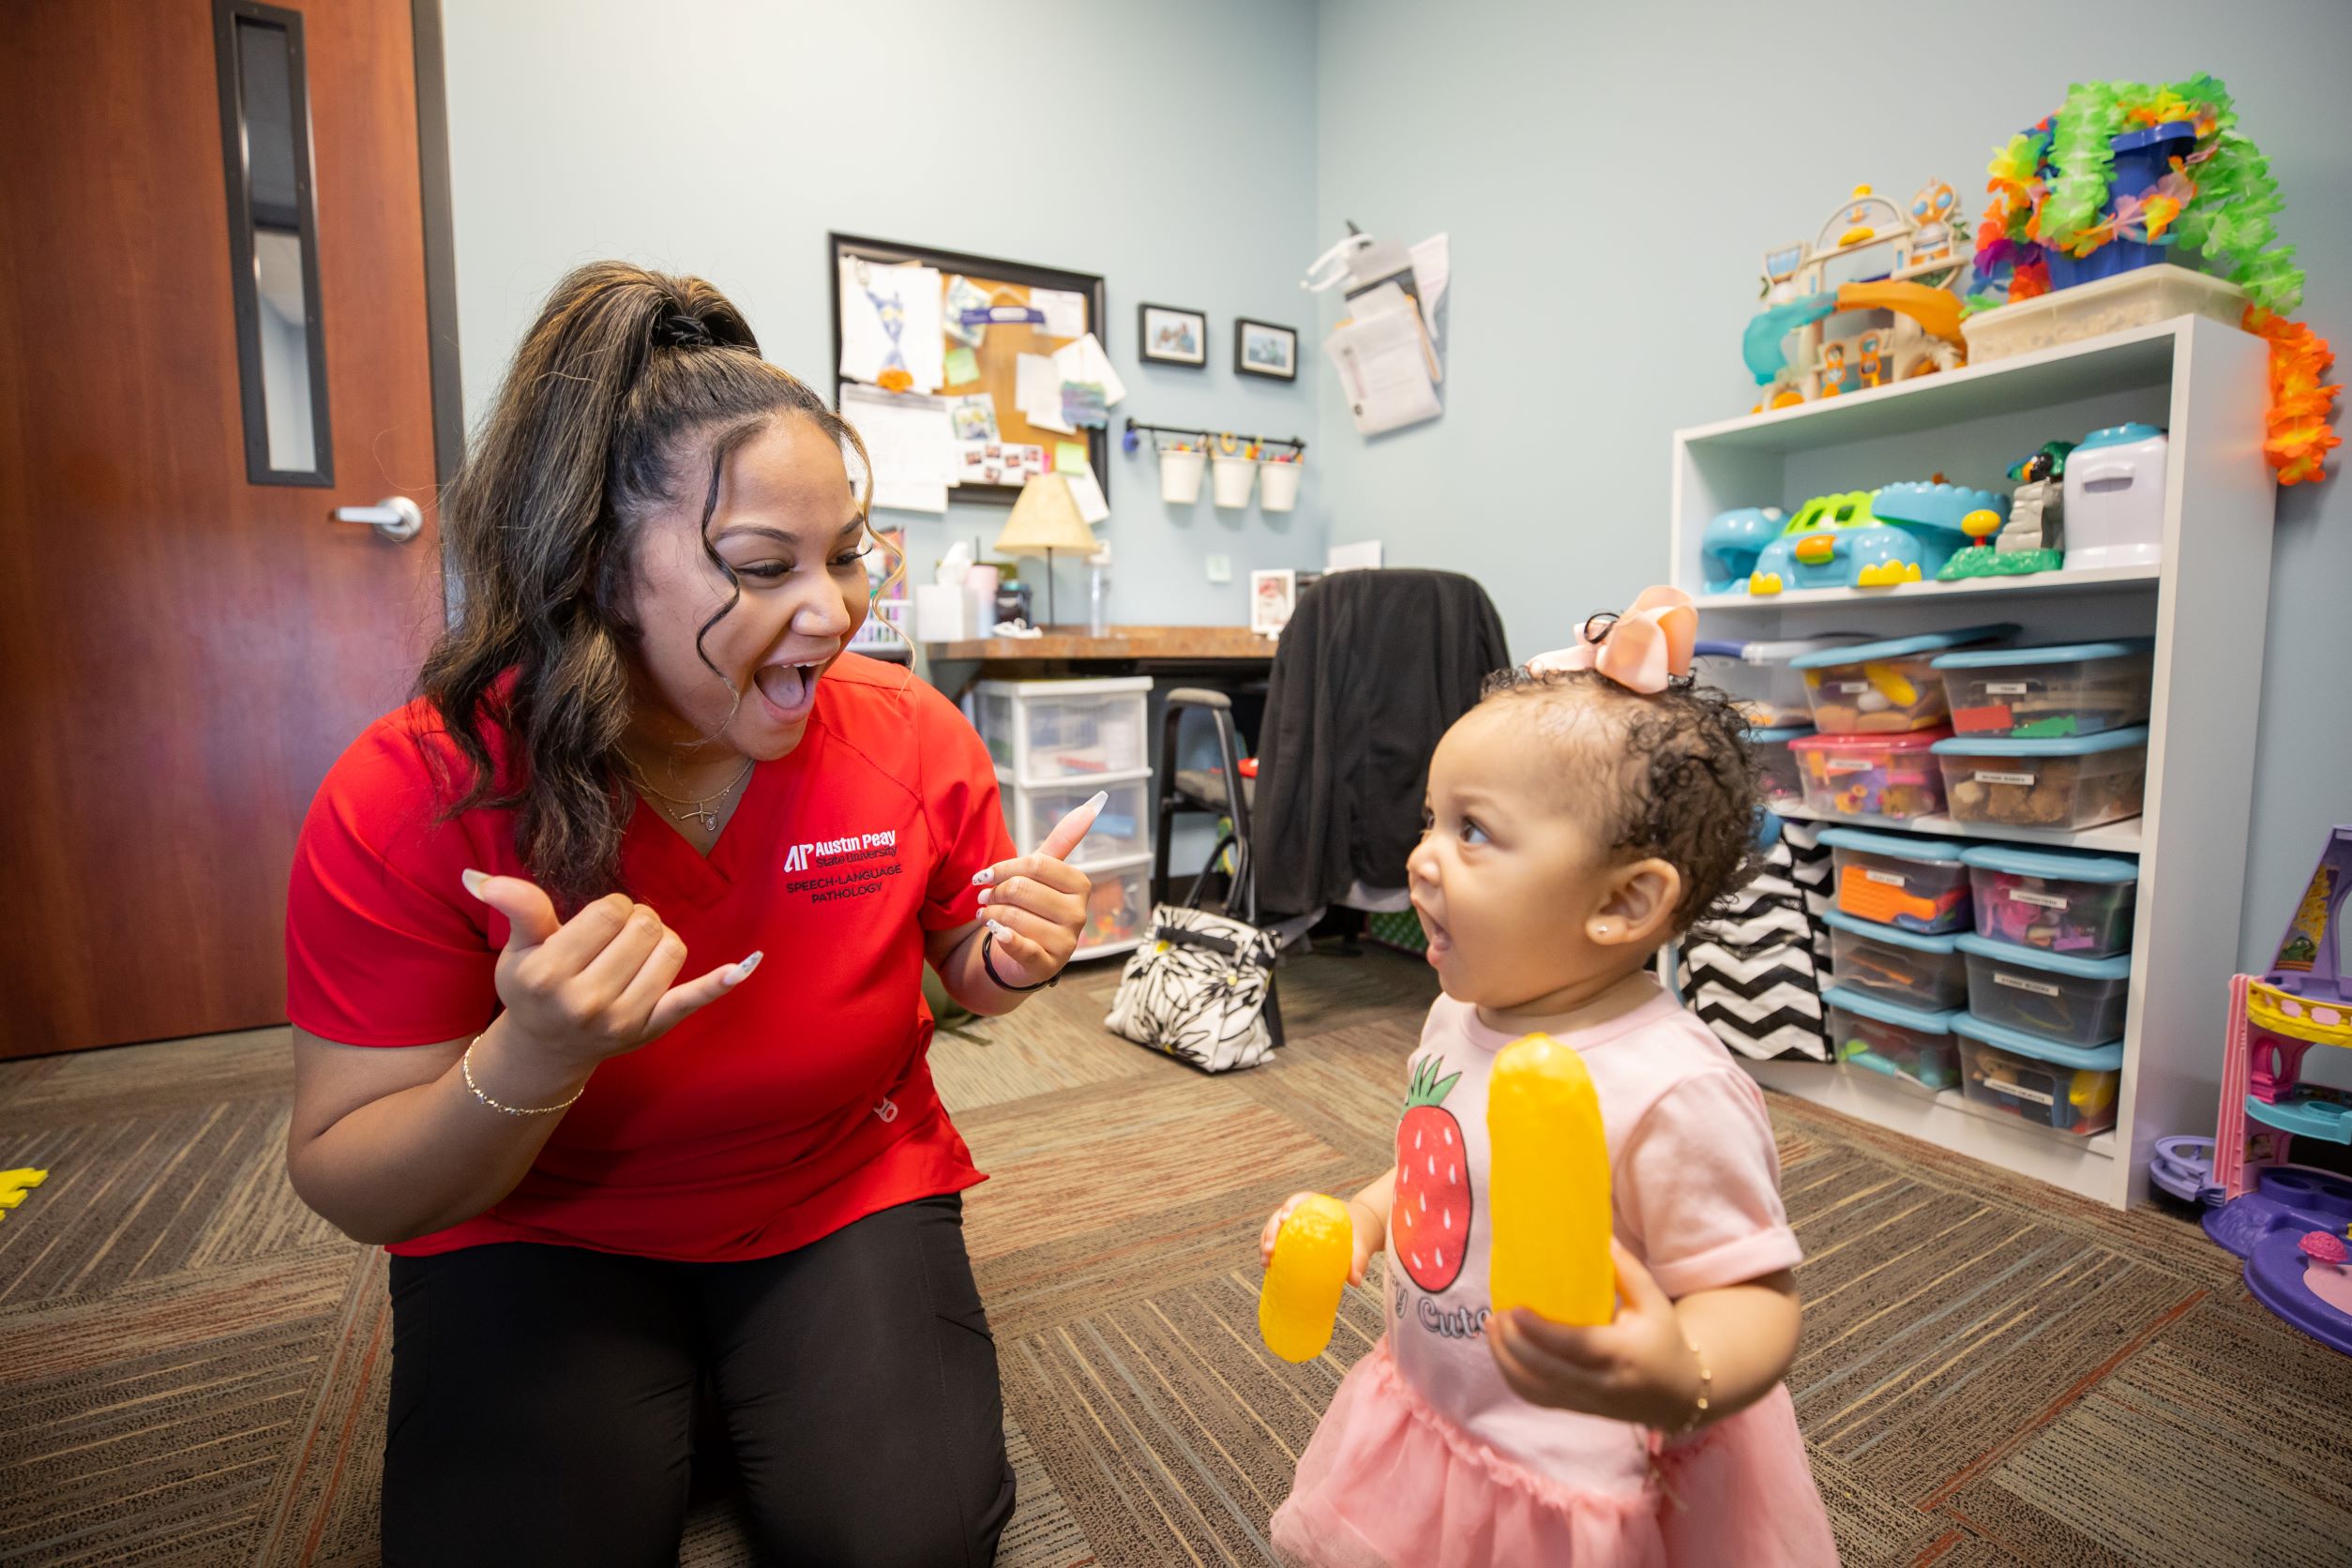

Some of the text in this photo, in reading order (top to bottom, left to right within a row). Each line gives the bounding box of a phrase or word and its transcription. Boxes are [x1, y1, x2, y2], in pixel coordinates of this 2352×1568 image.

[816, 830, 896, 857] Austin Peay
[815, 847, 897, 868] State University
[787, 864, 902, 894] SPEECH-LANGUAGE
[812, 882, 882, 903] PATHOLOGY
